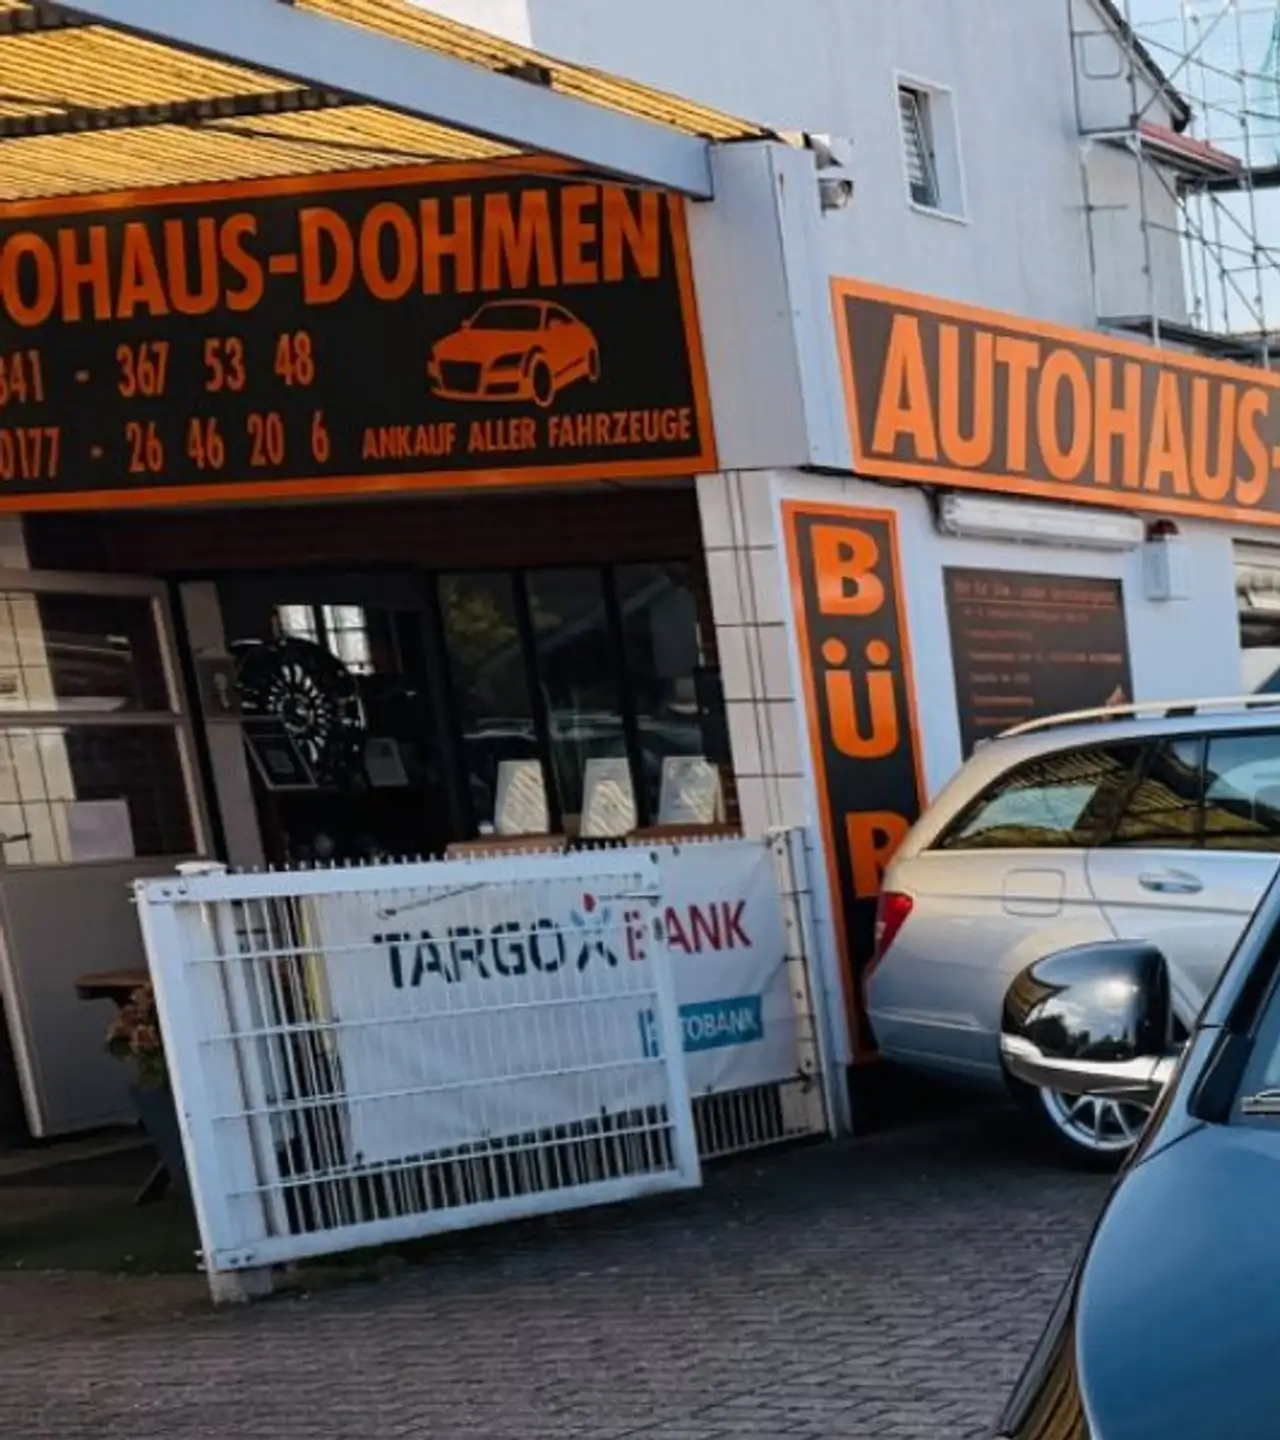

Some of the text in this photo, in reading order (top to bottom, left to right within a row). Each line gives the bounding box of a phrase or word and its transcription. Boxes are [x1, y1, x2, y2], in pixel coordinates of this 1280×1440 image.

[116, 341, 170, 398] 367
[204, 336, 246, 392] 53
[274, 330, 315, 386] 48
[125, 420, 164, 473] 26
[187, 416, 225, 470] 46
[247, 412, 285, 467] 20
[311, 409, 330, 463] 6
[362, 407, 693, 460] ANKAUF ALLER FAHRZEUGE
